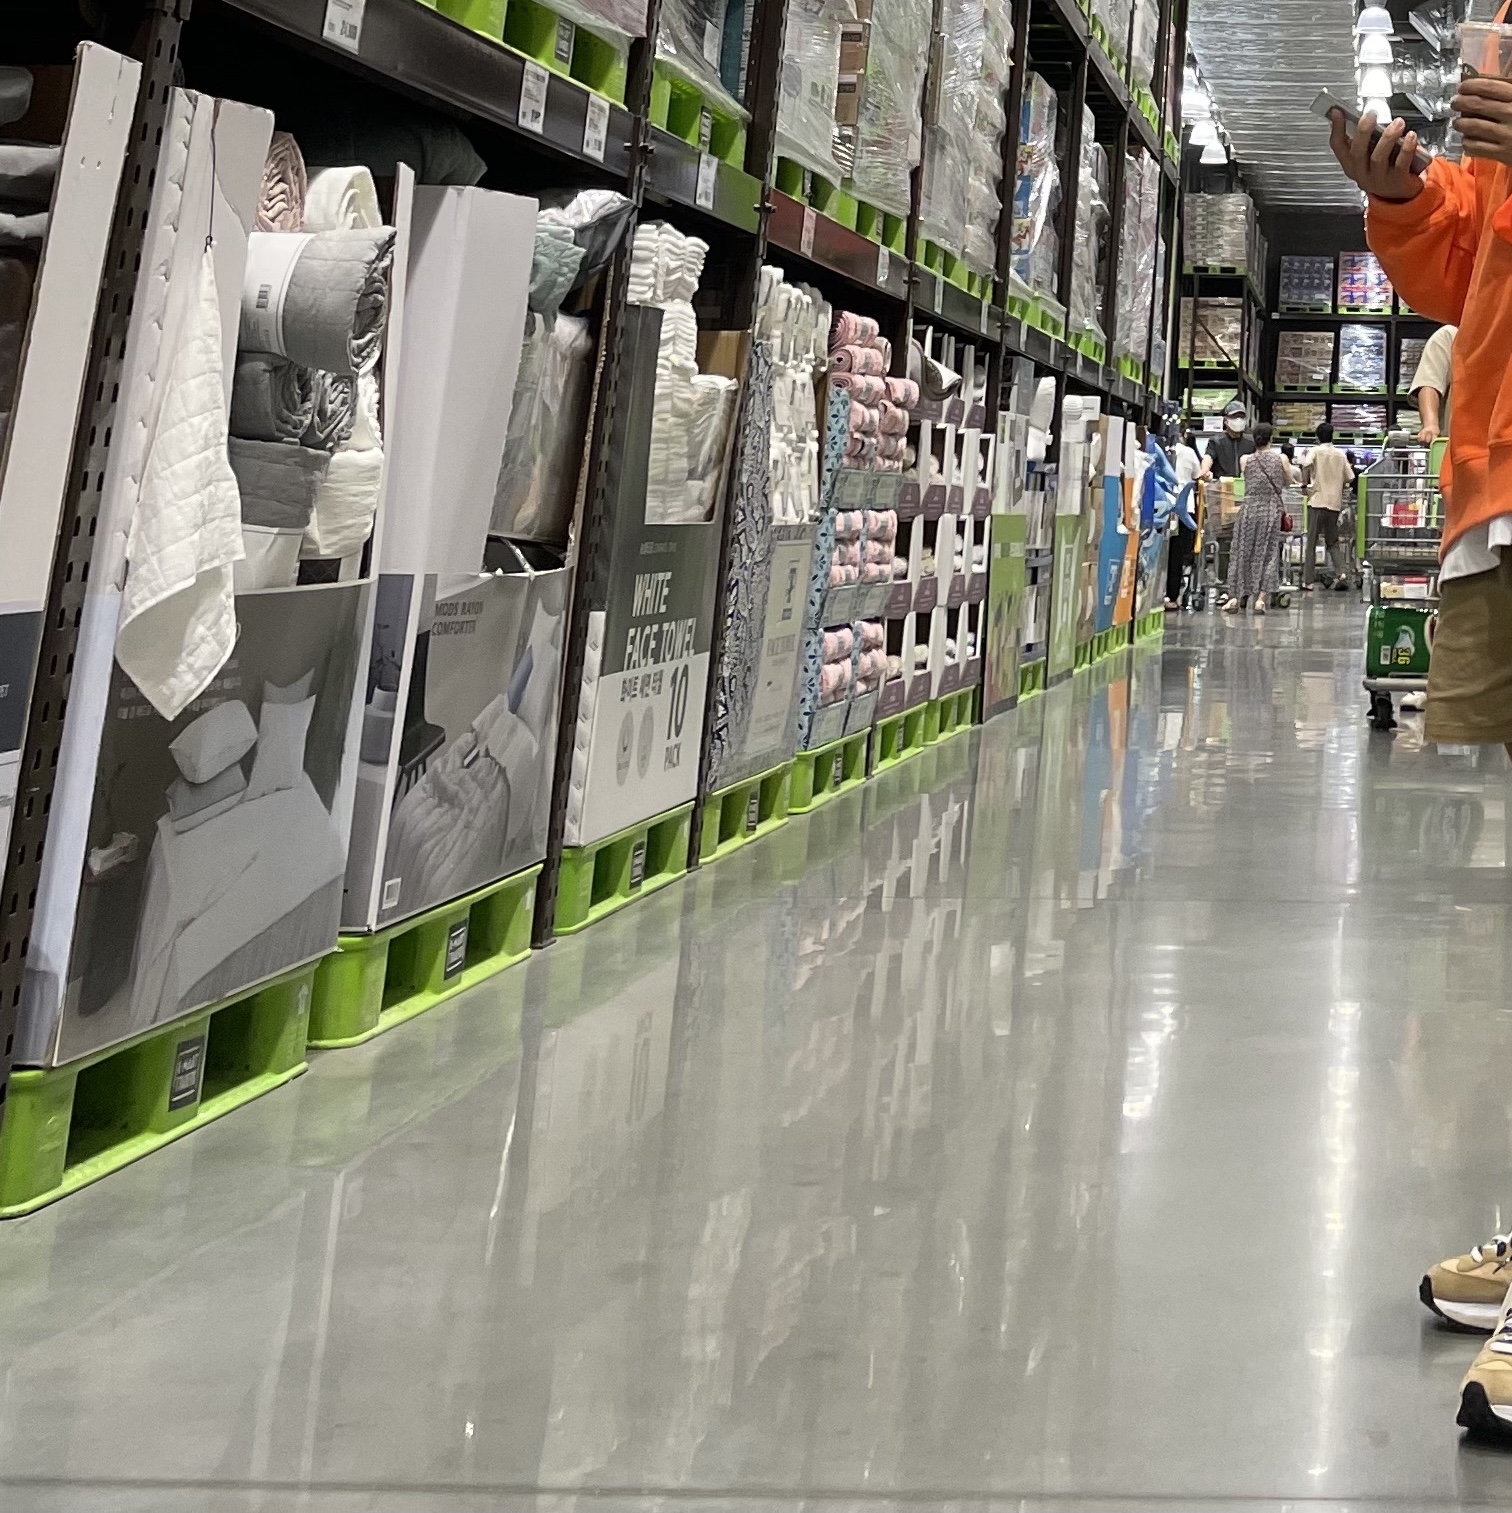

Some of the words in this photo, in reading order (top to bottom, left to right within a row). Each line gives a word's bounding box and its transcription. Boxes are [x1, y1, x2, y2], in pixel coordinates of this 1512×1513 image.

[632, 572, 672, 617] WHITE
[623, 624, 659, 671] FACE
[660, 618, 697, 663] TOWEL
[667, 664, 689, 740] 10
